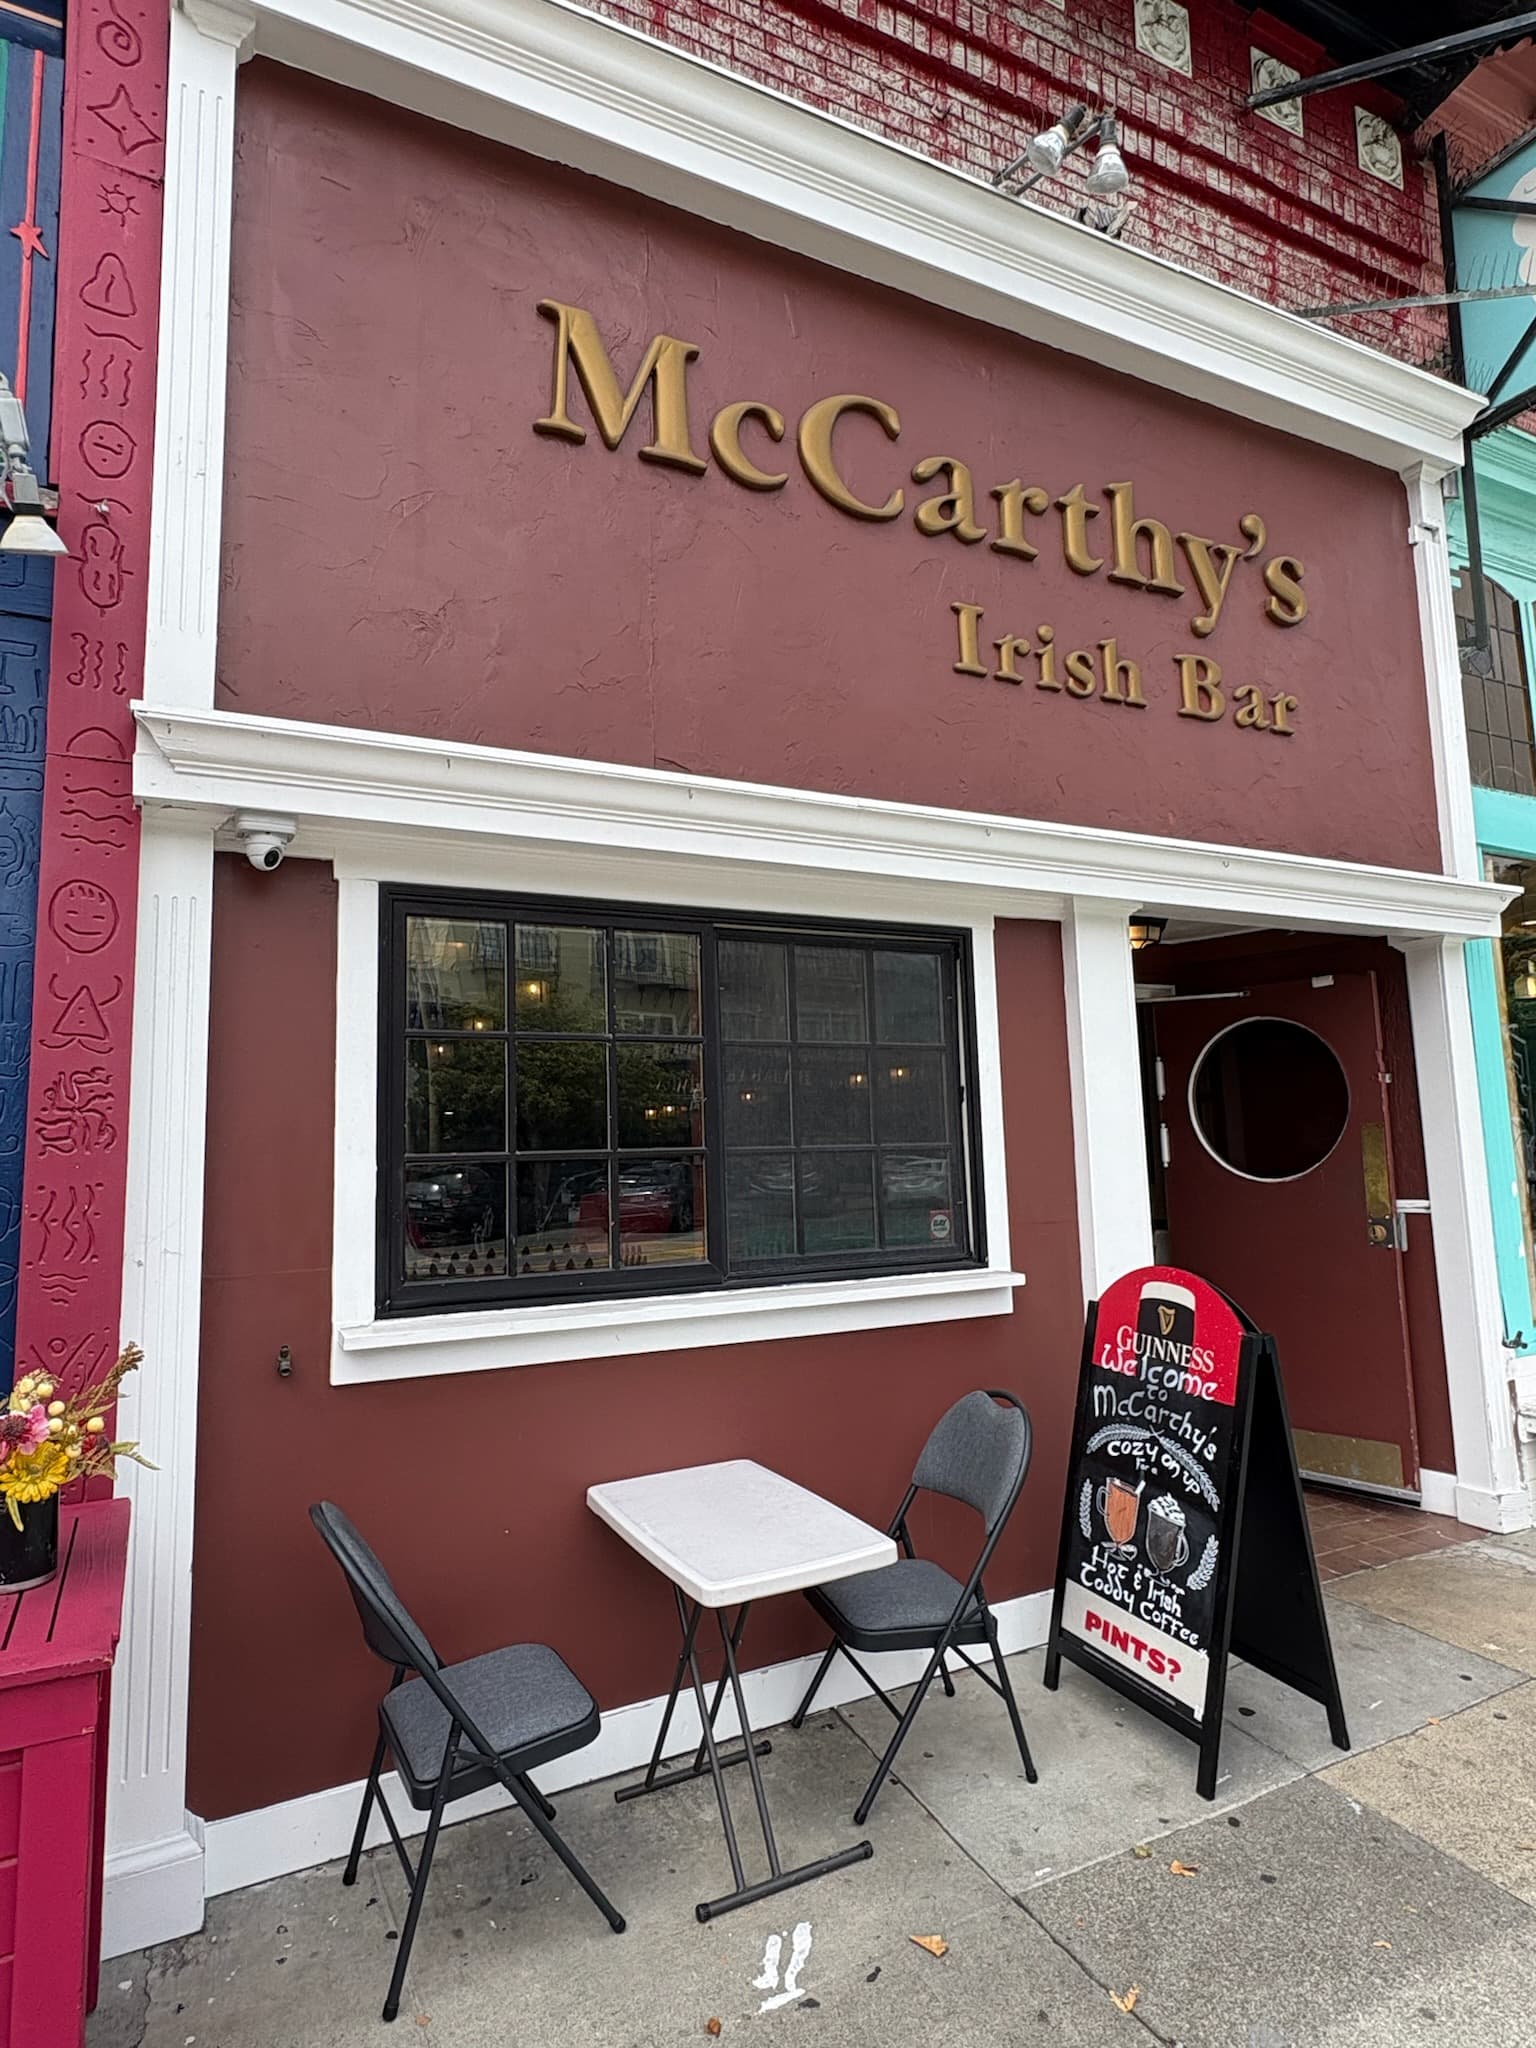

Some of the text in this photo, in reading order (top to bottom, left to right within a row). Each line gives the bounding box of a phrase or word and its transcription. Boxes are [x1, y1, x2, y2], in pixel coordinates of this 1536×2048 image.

[533, 298, 1308, 636] McCarthy's
[950, 602, 1298, 737] Irish Bar
[1101, 1344, 1218, 1400] Welcome
[1116, 1325, 1214, 1373] GUINNESS
[1093, 1384, 1217, 1461] McCarthy's
[1146, 1384, 1168, 1401] to
[1161, 1453, 1180, 1478] on
[1183, 1470, 1200, 1494] up
[1092, 1545, 1129, 1579] Hot
[1147, 1579, 1182, 1617] Irish
[1084, 1609, 1182, 1682] PINTS?
[1140, 1601, 1199, 1646] Coffee
